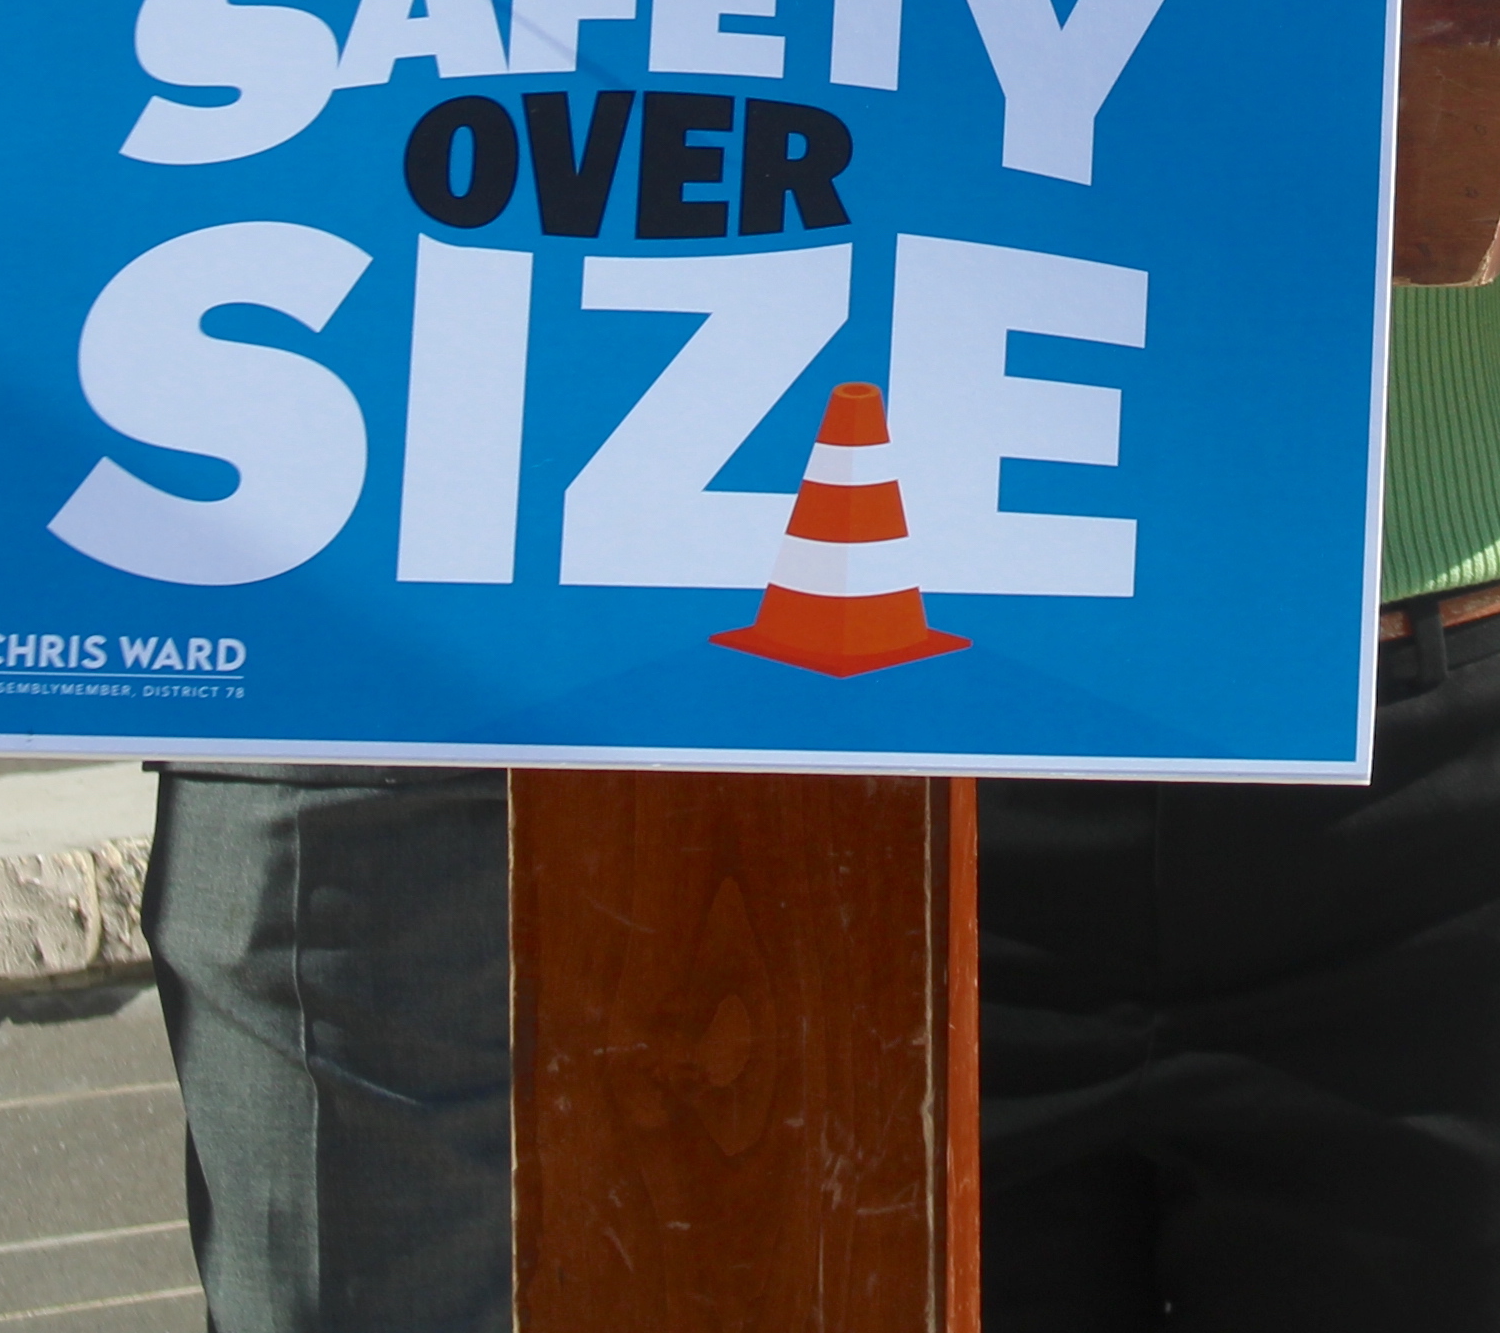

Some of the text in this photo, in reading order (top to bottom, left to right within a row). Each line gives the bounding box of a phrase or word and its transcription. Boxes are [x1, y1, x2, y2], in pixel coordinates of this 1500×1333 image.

[402, 89, 853, 240] OVER
[46, 219, 1150, 598] SIZE
[118, 635, 247, 672] WARD
[143, 684, 219, 699] DISTRICT
[225, 685, 245, 700] 78
